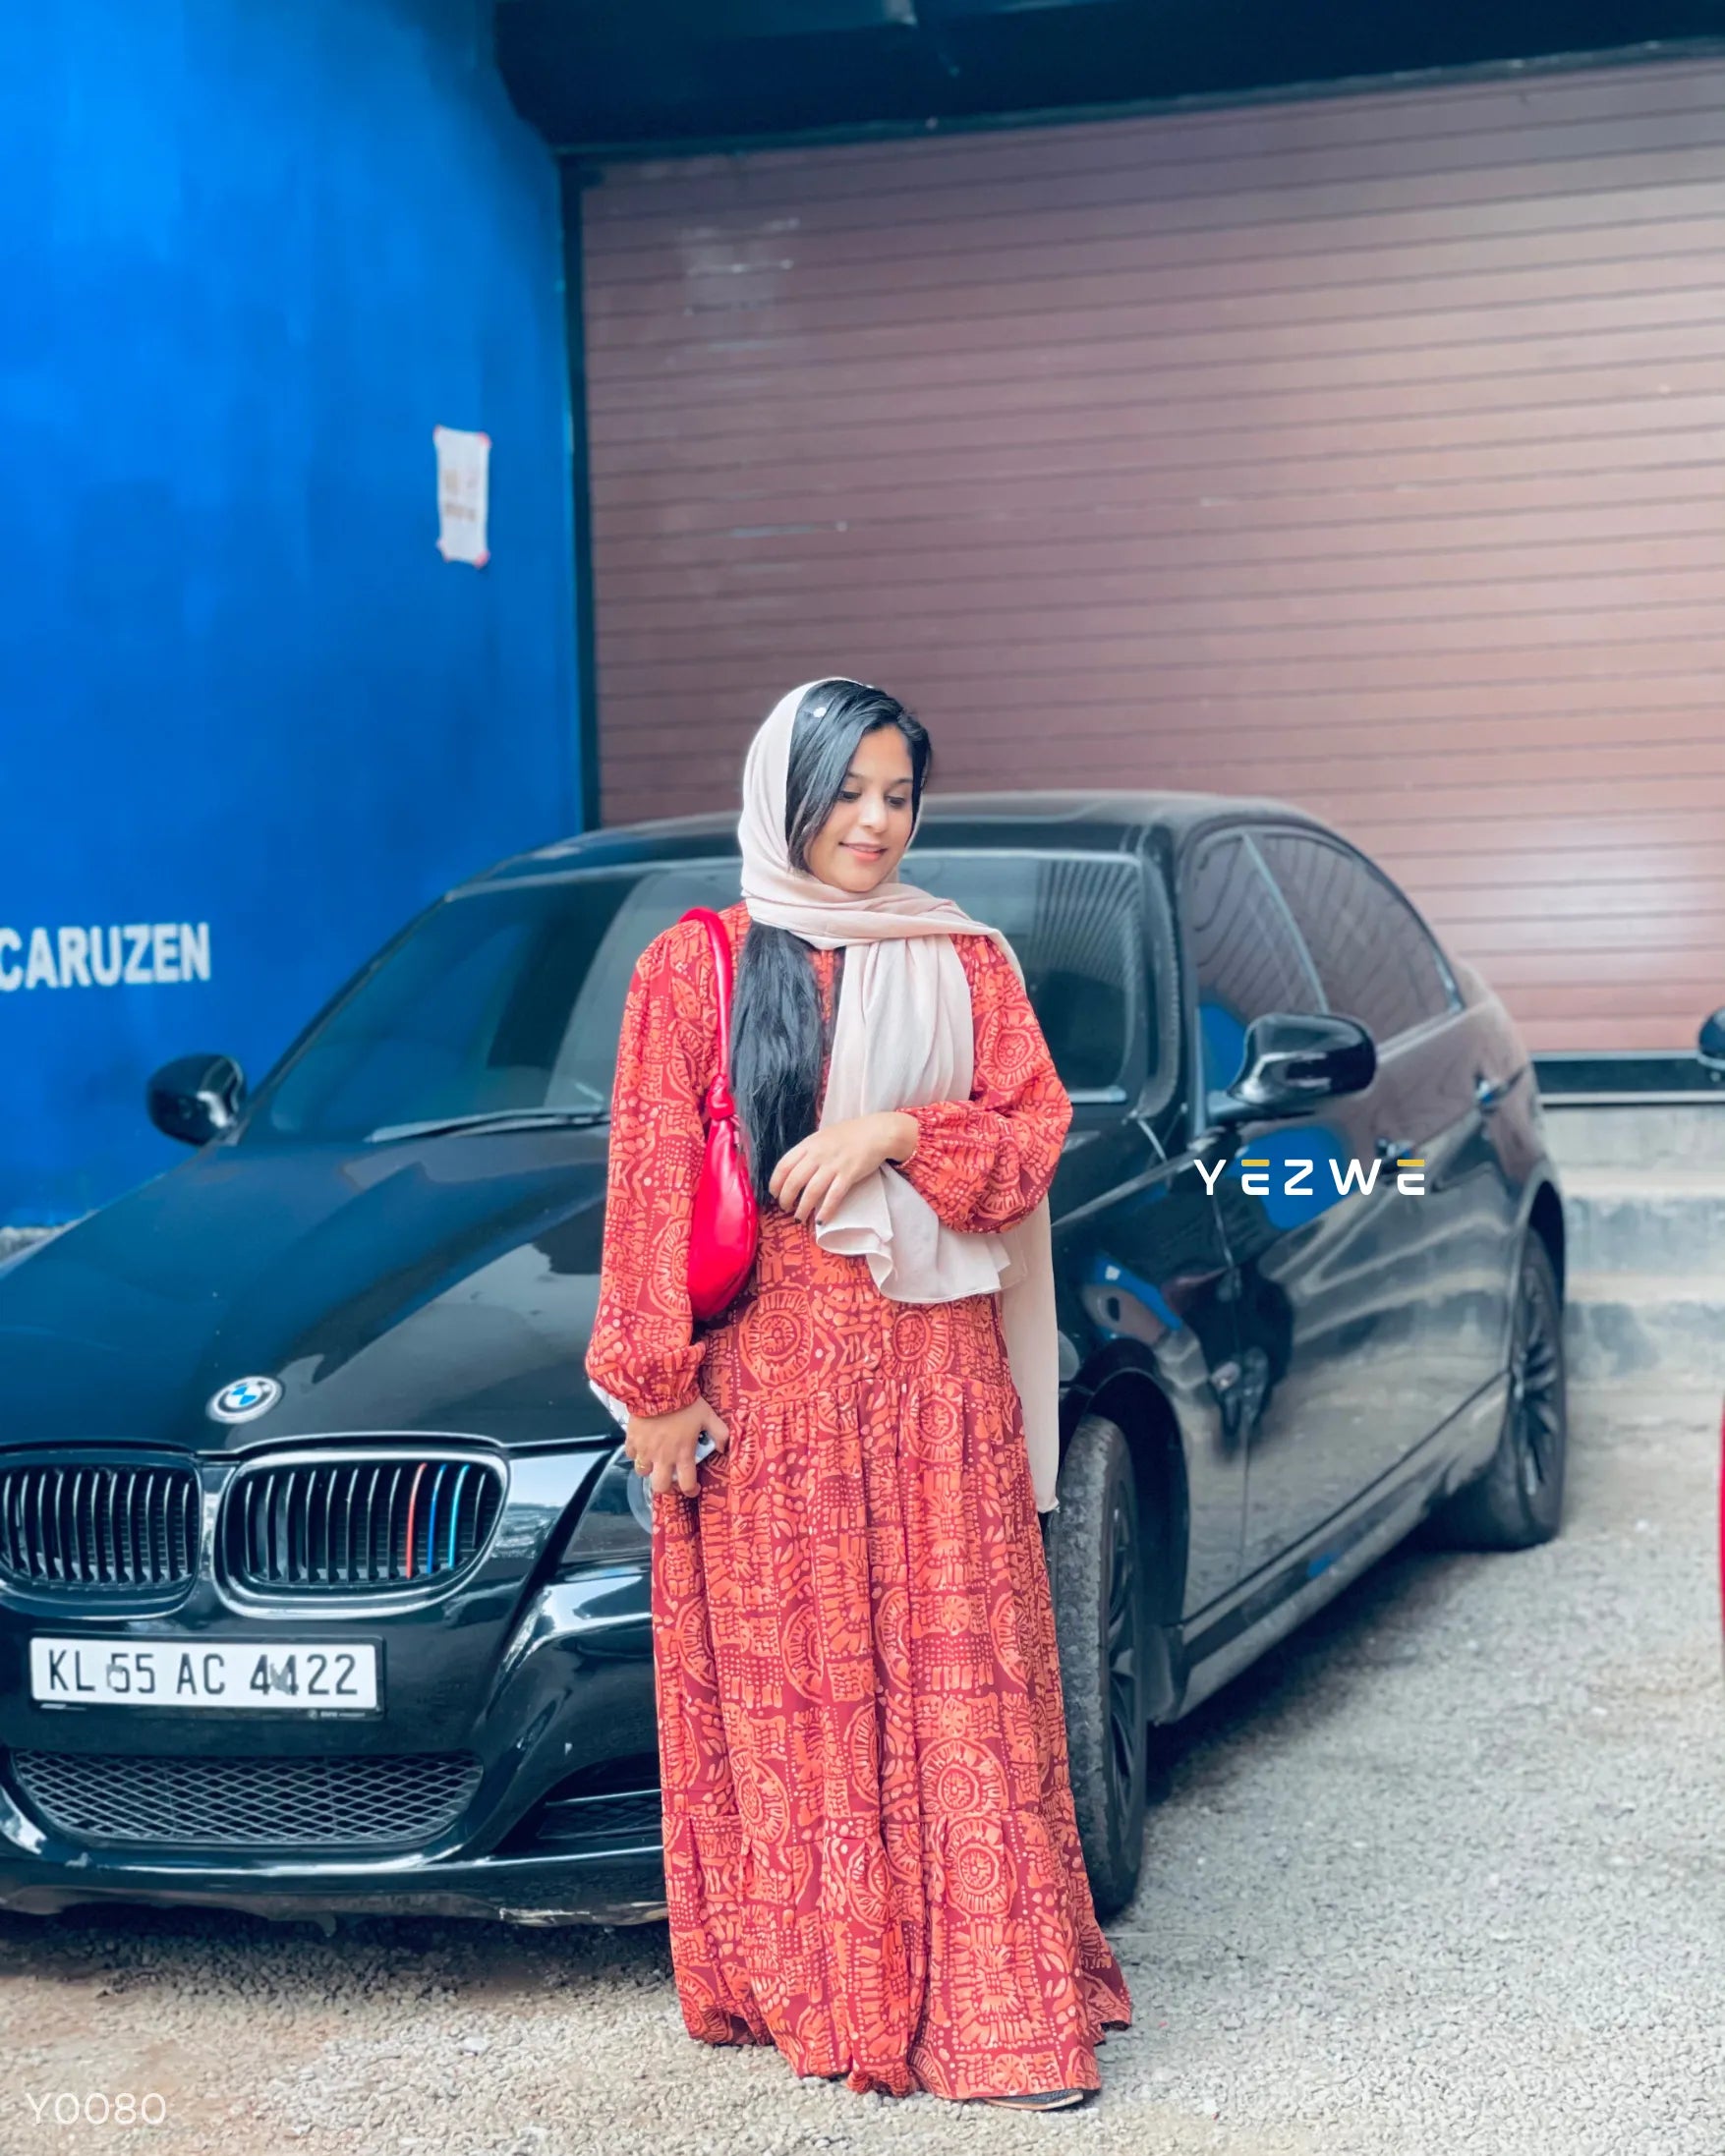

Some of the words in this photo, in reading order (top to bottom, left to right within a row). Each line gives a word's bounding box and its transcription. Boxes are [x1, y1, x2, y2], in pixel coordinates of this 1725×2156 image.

[0, 922, 210, 991] CARUZEN
[48, 1649, 95, 1691] KL
[177, 1653, 225, 1694] AC
